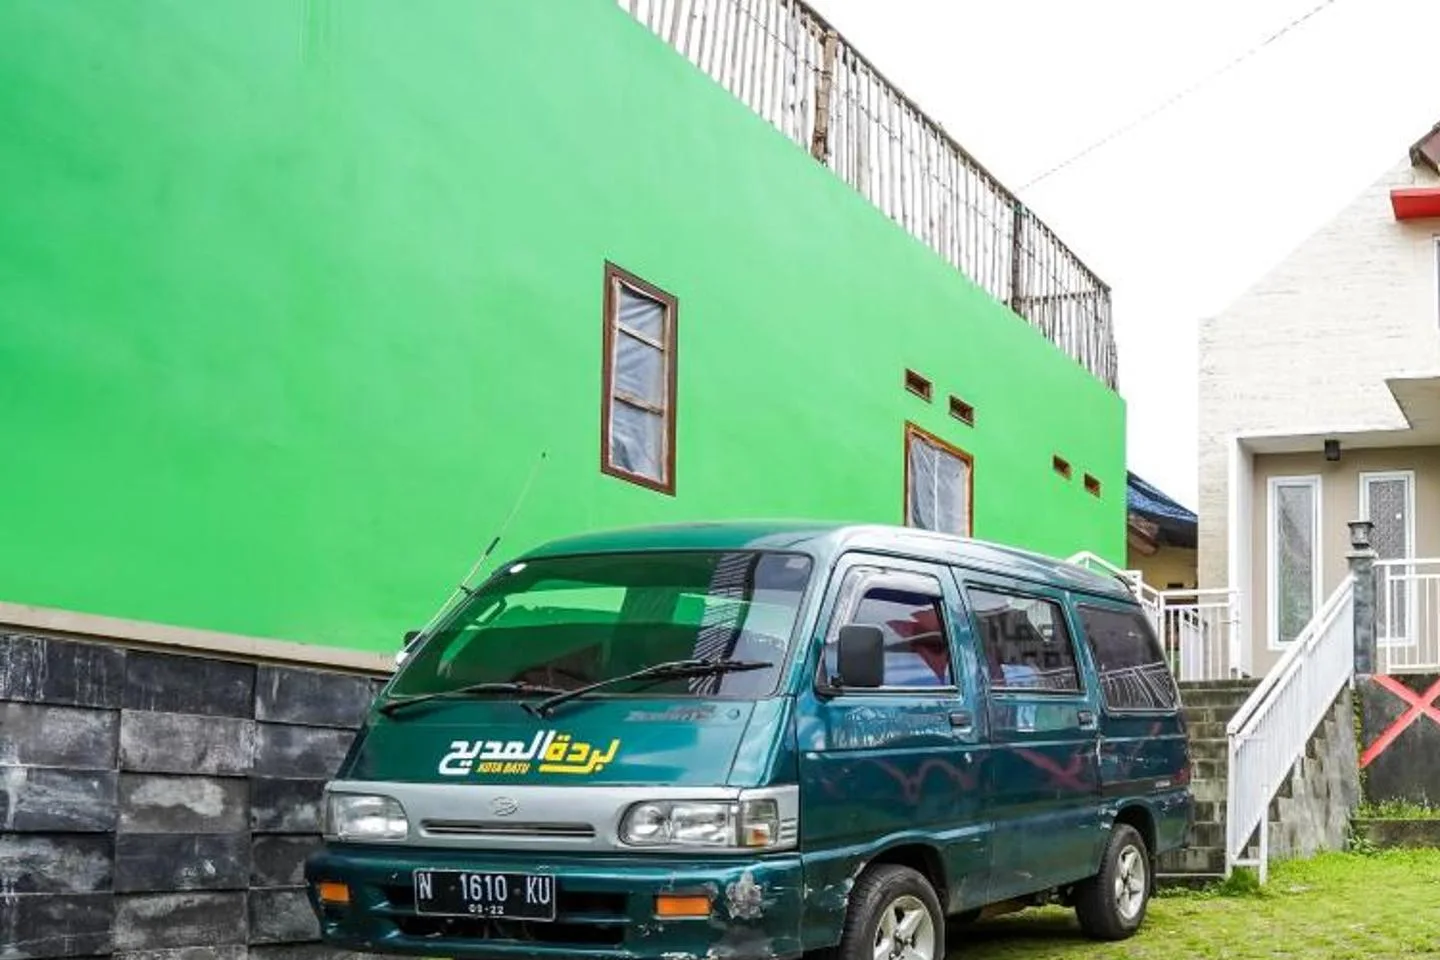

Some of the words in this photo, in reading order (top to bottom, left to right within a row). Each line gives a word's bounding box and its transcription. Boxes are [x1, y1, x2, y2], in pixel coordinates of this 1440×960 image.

[476, 761, 502, 774] KOTA
[503, 762, 530, 774] BATU
[419, 873, 433, 900] N
[460, 874, 508, 901] 1610
[526, 876, 551, 904] KU
